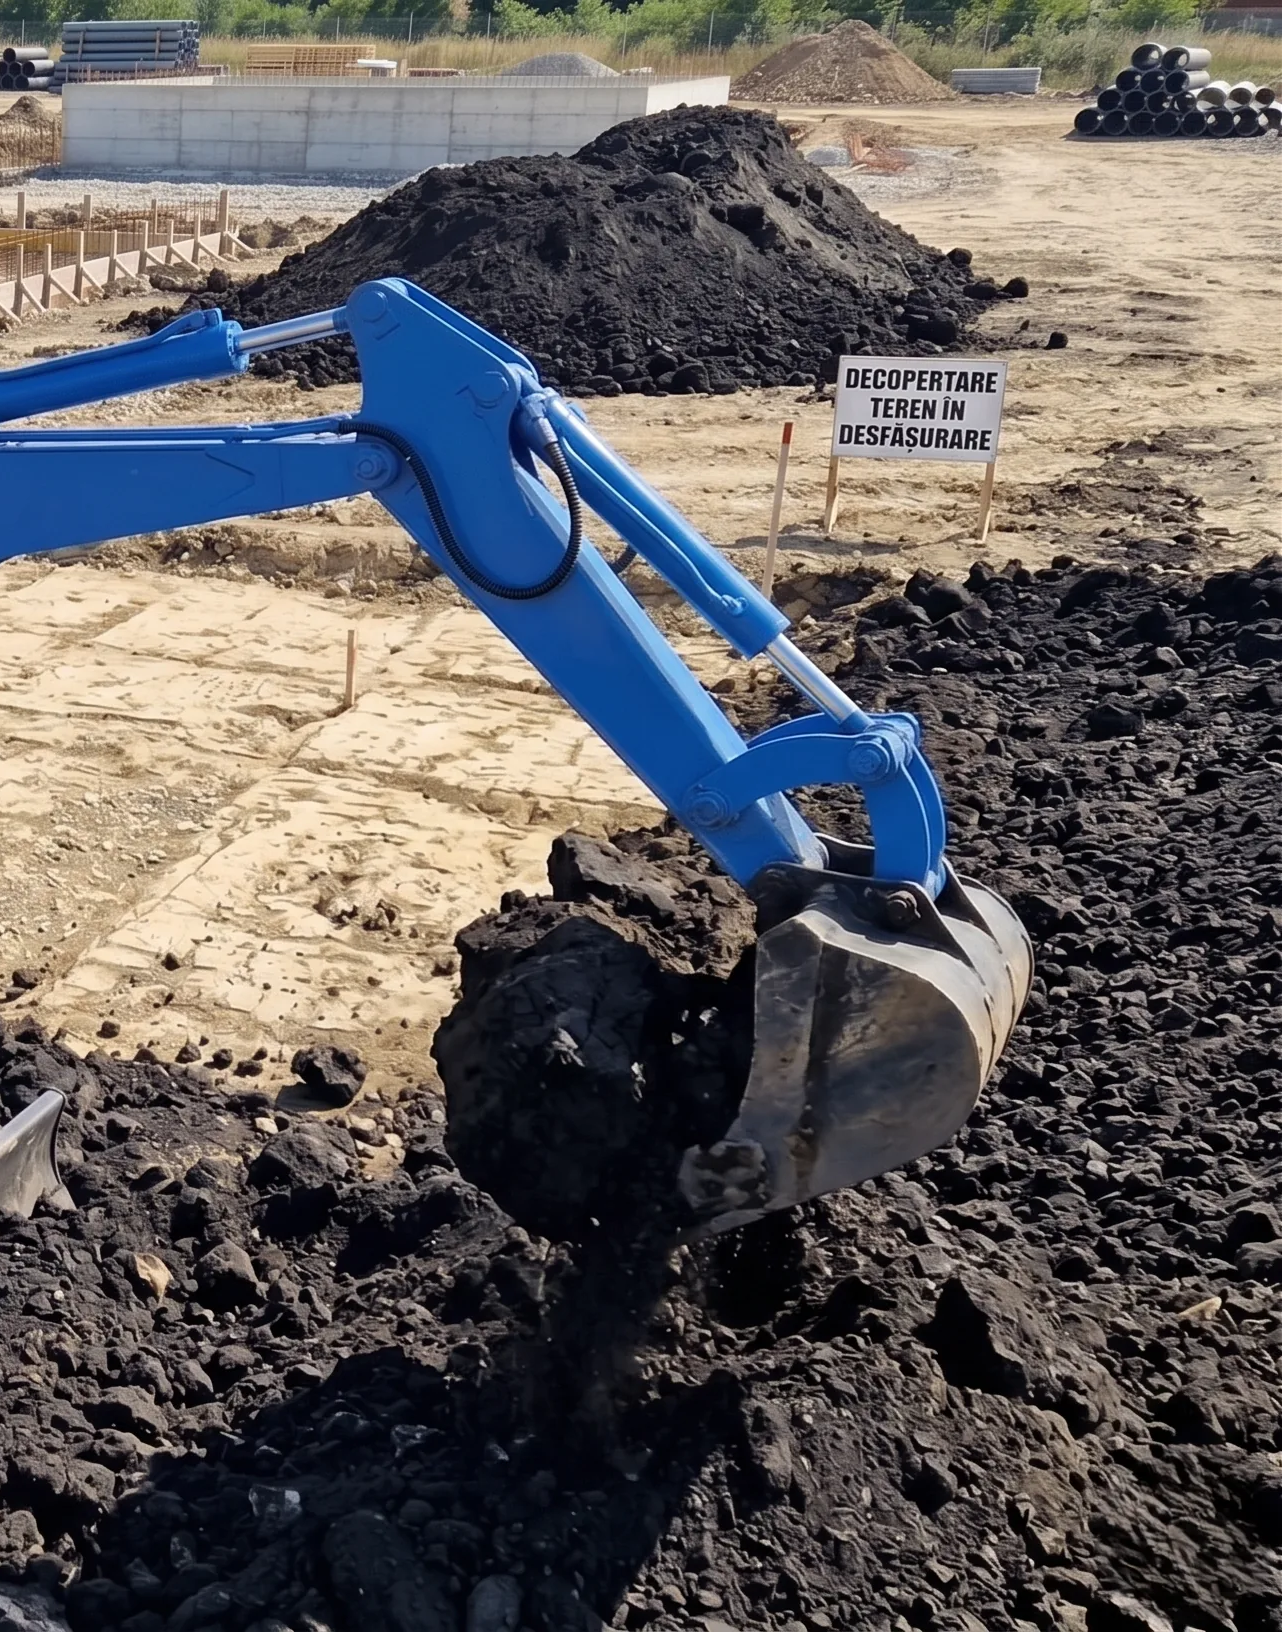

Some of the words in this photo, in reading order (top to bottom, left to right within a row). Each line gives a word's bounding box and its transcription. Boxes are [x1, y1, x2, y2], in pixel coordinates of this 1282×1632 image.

[845, 368, 998, 393] DECOPERTARE
[870, 397, 937, 420] TEREN
[942, 395, 966, 421] ÎN
[838, 422, 992, 453] DESFĂȘURARE
